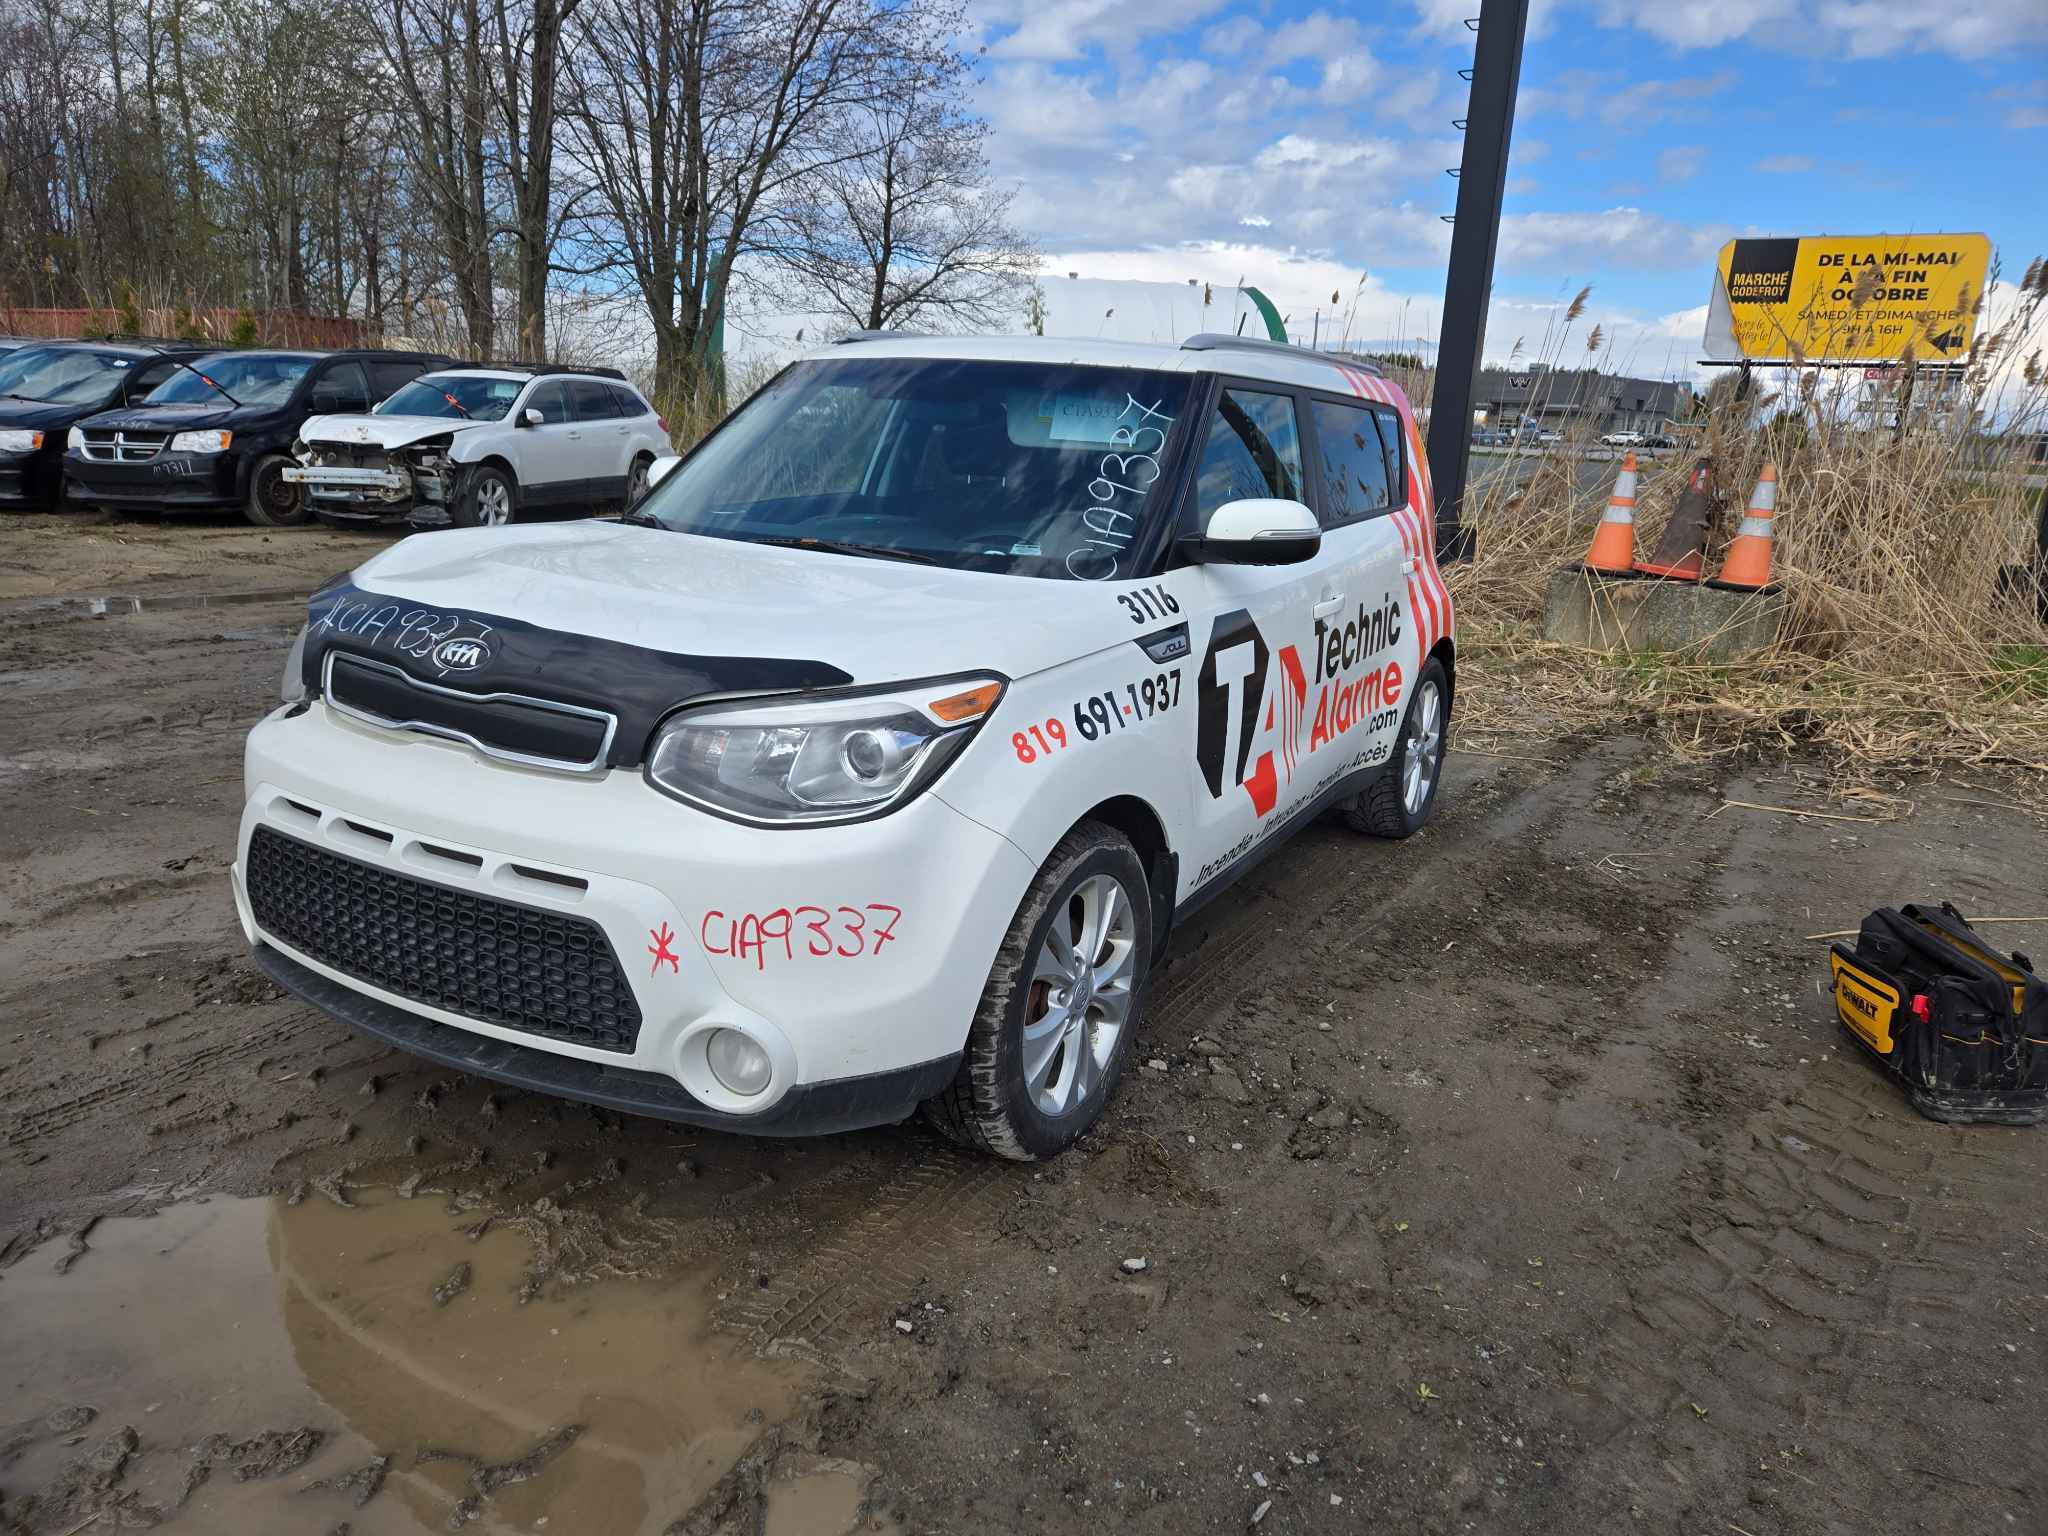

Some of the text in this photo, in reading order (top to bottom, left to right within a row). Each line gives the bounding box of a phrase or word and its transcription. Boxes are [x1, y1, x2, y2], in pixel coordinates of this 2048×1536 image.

[1818, 252, 1958, 267] DE LA MI-MAI
[1733, 271, 1790, 286] MARCHÉ
[1839, 268, 1853, 283] À
[1892, 271, 1928, 283] FIN
[1731, 286, 1786, 297] GODEFROY
[1831, 287, 1930, 301] OCOBRE
[1855, 310, 1874, 321] ET
[1879, 325, 1904, 335] 16H
[1117, 584, 1180, 624] 3116
[1314, 592, 1401, 685] Technic
[1310, 661, 1402, 753] Alarme
[1011, 668, 1182, 764] 819 691-1937
[701, 903, 902, 970] CIA9337
